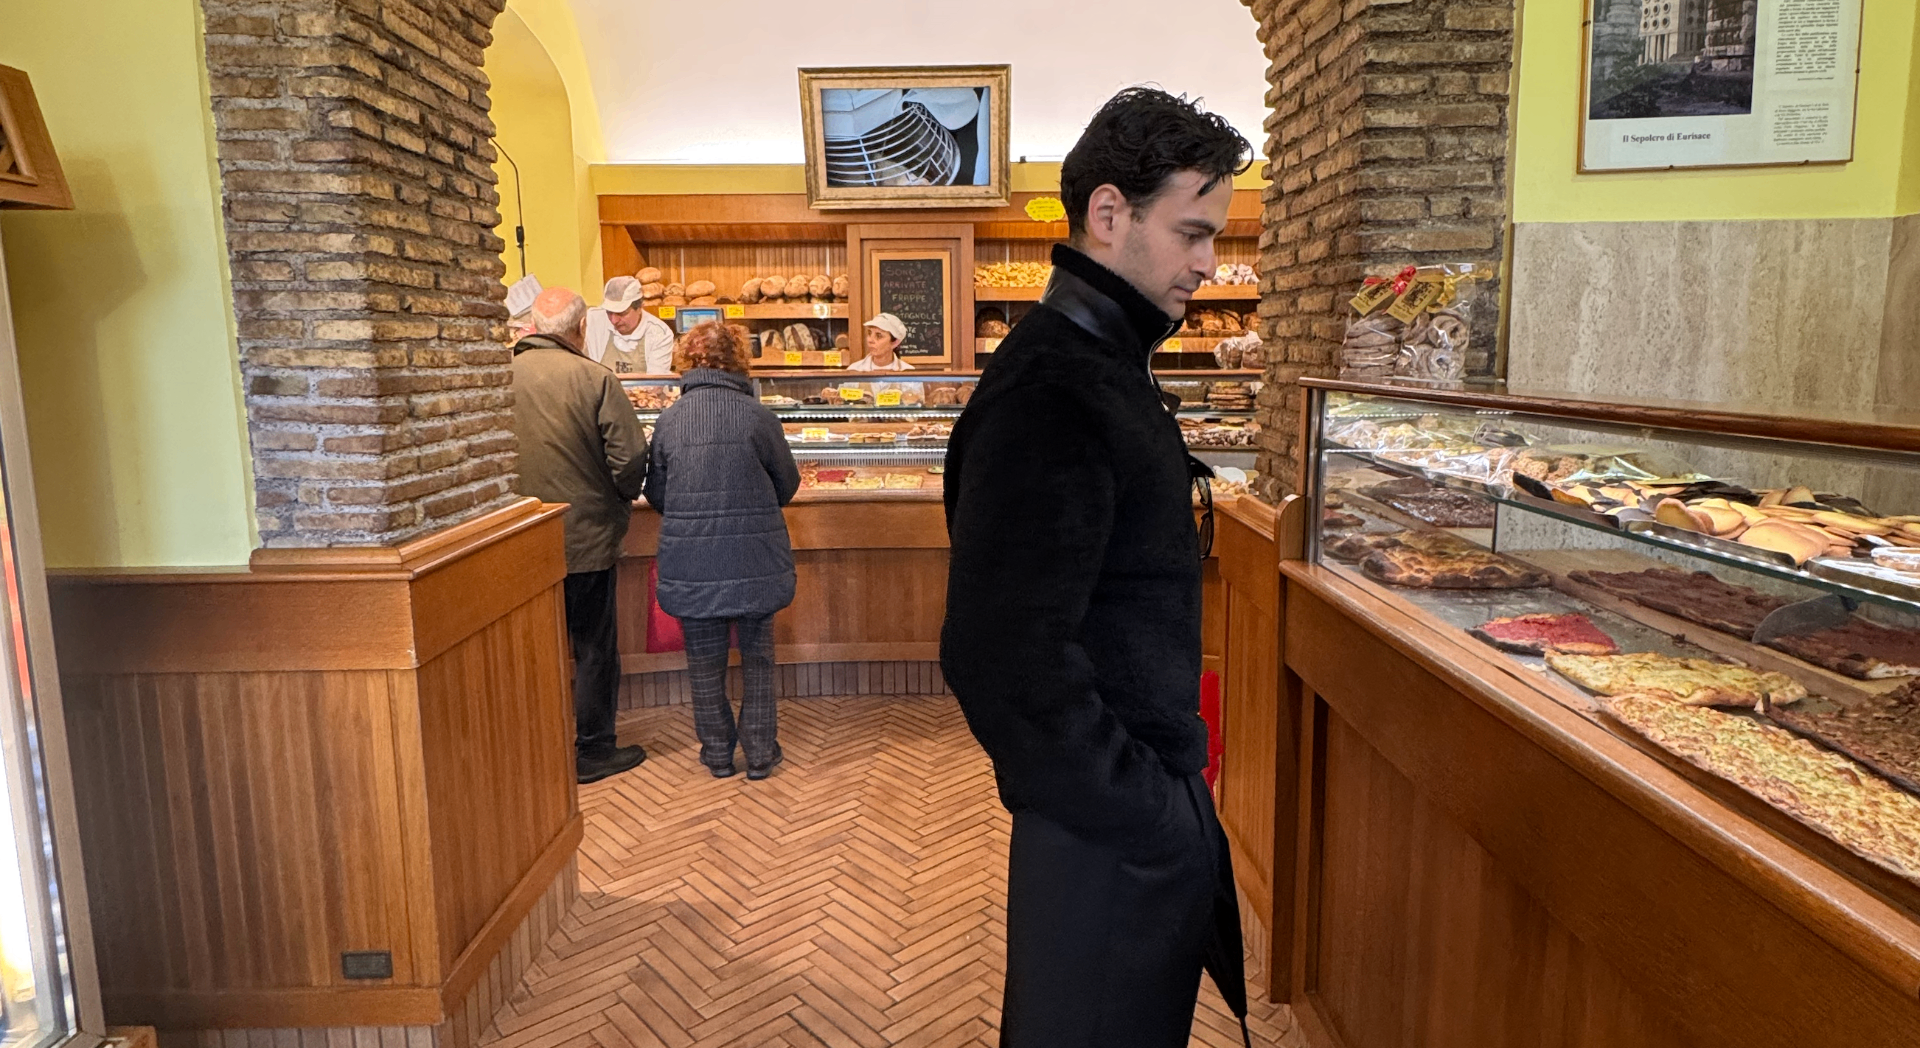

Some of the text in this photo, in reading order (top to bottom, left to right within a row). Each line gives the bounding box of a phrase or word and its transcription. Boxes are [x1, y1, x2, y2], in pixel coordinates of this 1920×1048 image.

[1623, 132, 1711, 144] Il Sepolcro di Eurisace
[884, 280, 926, 289] ARRIVATE
[892, 293, 926, 302] FRAPPE
[895, 312, 937, 321] TAGNOLE
